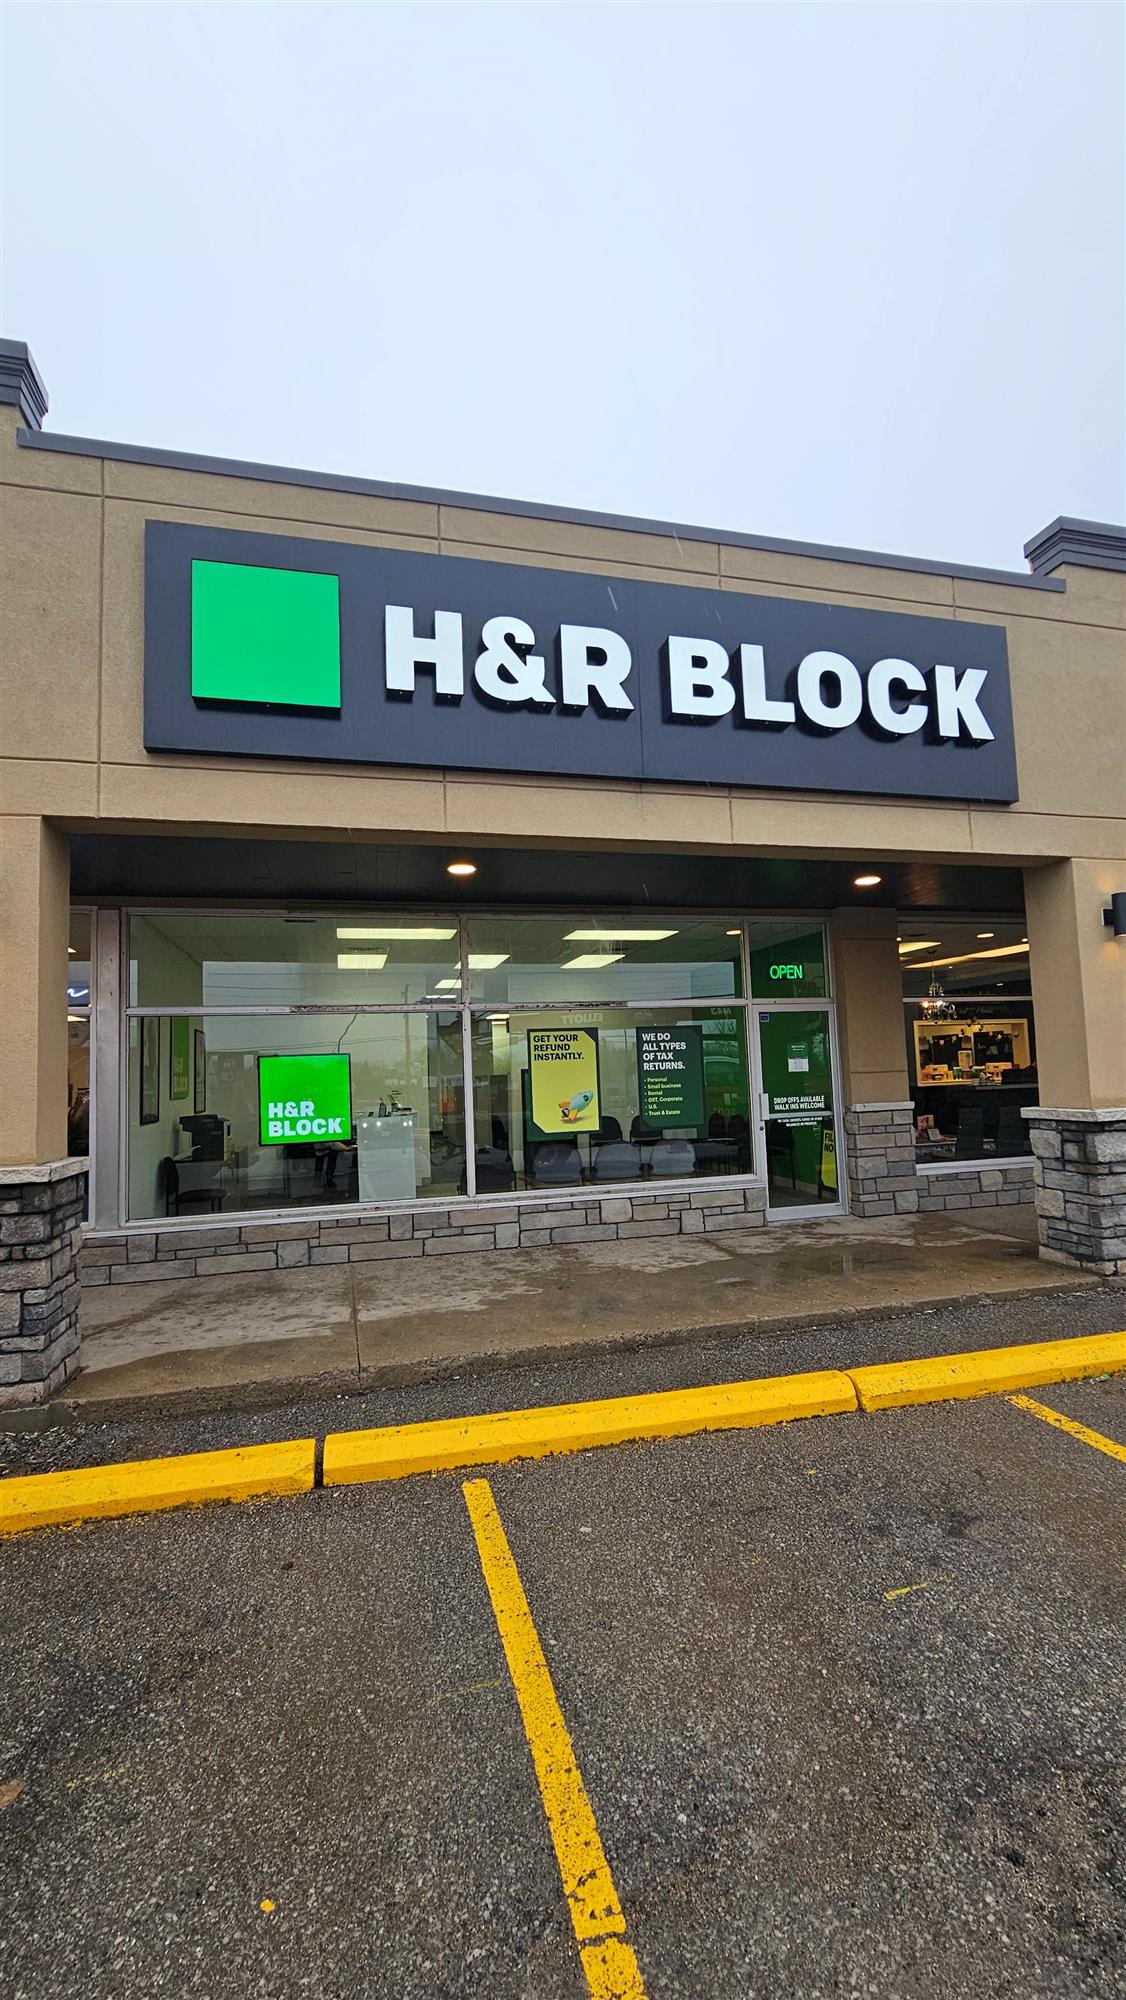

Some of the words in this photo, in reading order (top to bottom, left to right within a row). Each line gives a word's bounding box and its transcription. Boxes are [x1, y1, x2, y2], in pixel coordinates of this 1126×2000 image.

[385, 605, 634, 709] H&R
[668, 635, 995, 740] BLOCK
[770, 965, 802, 979] OPEN
[533, 1035, 551, 1043] GET
[553, 1034, 578, 1042] YOUR
[642, 1033, 656, 1041] WE
[657, 1032, 671, 1041] DO
[534, 1043, 570, 1052] REFUND
[642, 1042, 659, 1051] ALL
[659, 1041, 686, 1050] TYPES
[534, 1052, 584, 1061] INSTANTLY.
[643, 1052, 655, 1060] OF
[656, 1051, 674, 1060] TAX
[643, 1061, 686, 1070] RETURNS.
[268, 1101, 315, 1118] H&R
[800, 1101, 825, 1109] WELCOME
[268, 1117, 343, 1137] BLOCK
